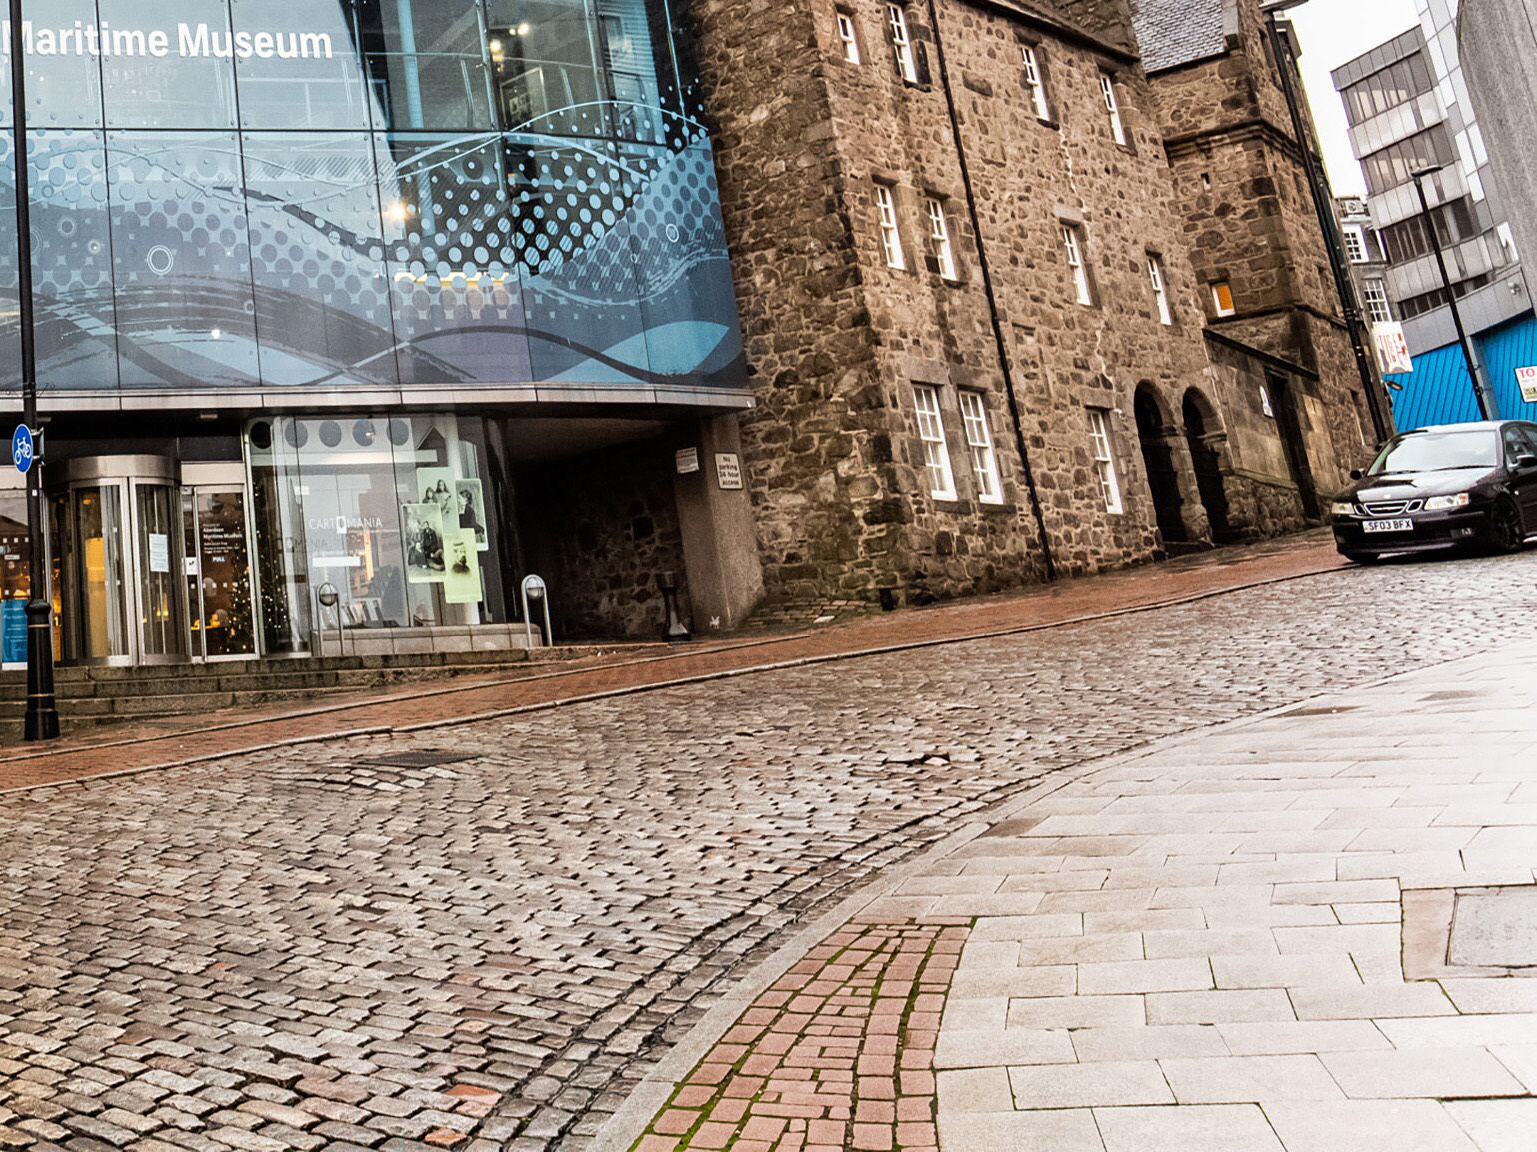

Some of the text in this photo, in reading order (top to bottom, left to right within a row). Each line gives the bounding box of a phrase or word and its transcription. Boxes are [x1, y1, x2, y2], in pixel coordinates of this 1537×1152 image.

[1, 19, 333, 58] Maritime Museum
[309, 516, 383, 531] CARTOMANIA
[1368, 521, 1391, 530] SF03
